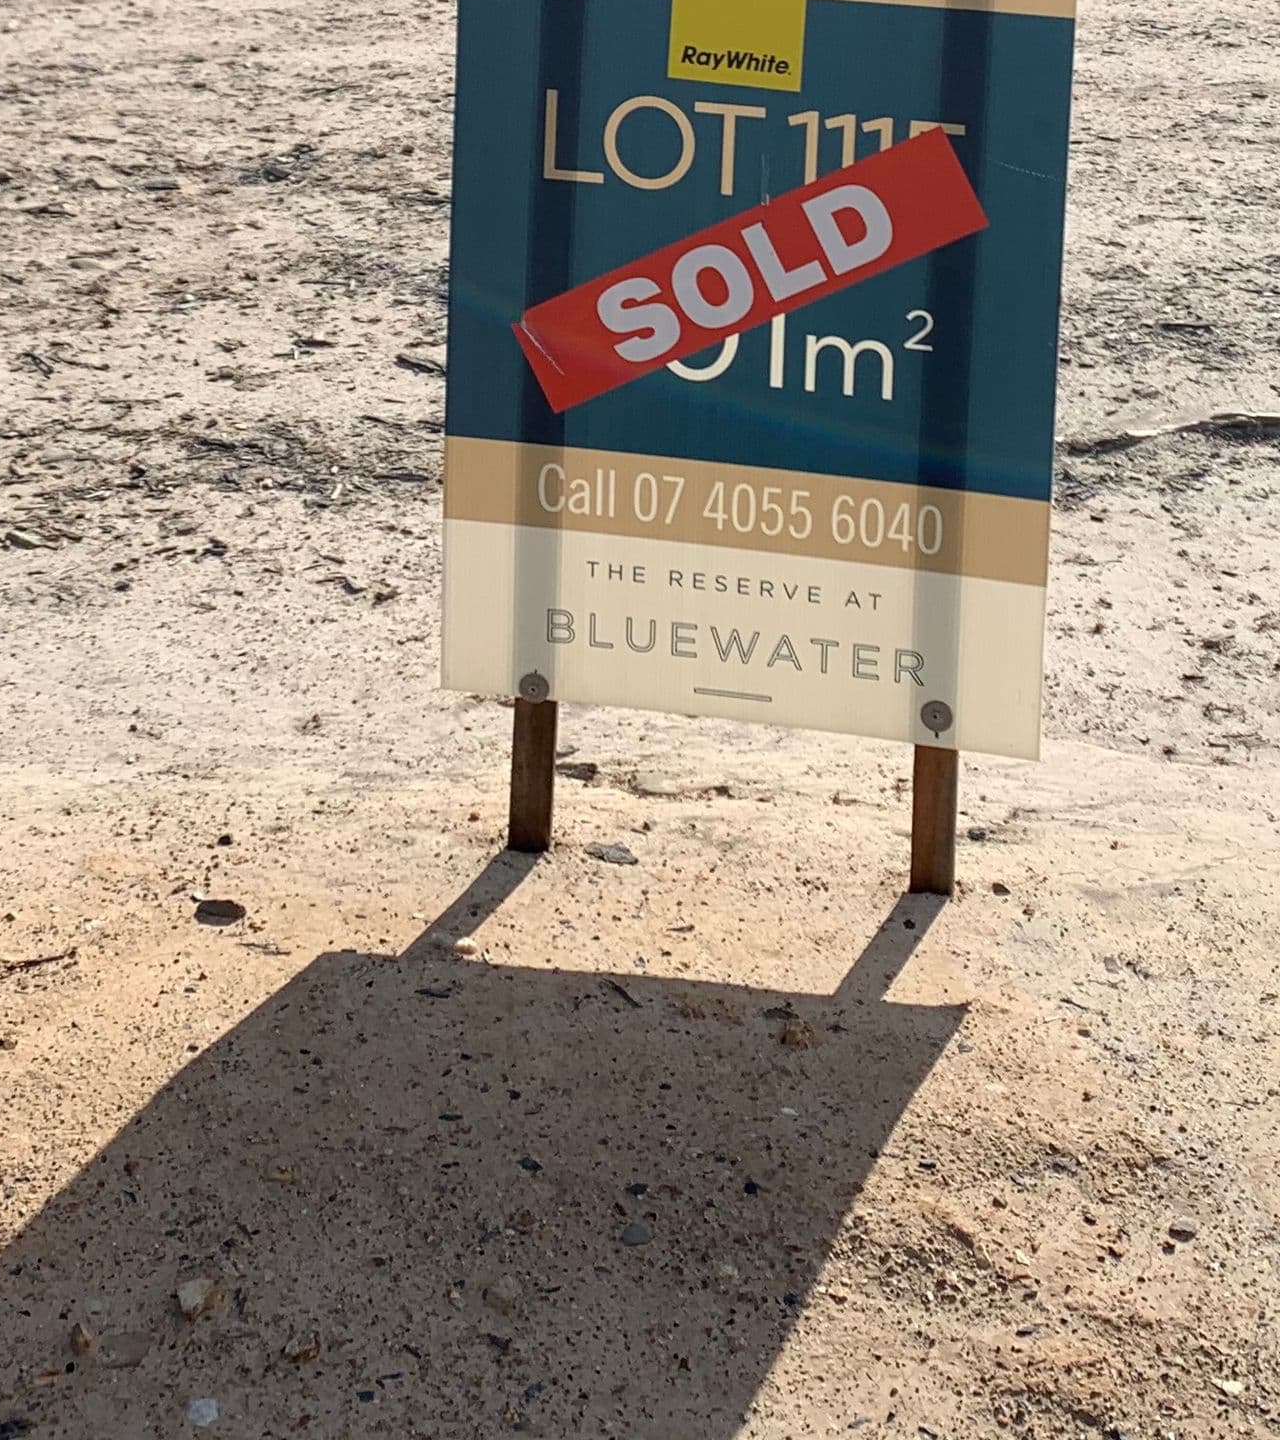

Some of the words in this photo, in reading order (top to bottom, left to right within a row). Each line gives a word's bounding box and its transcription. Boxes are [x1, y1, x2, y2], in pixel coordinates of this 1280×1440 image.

[543, 88, 766, 196] LOT
[596, 184, 893, 361] SOLD
[537, 463, 616, 518] Call
[633, 472, 686, 525] 07
[702, 481, 813, 540] 4055
[830, 495, 944, 556] 6040
[586, 560, 646, 584] THE
[668, 569, 822, 605] RESERVE
[845, 591, 883, 611] AT
[545, 607, 926, 687] BLUEWATER
